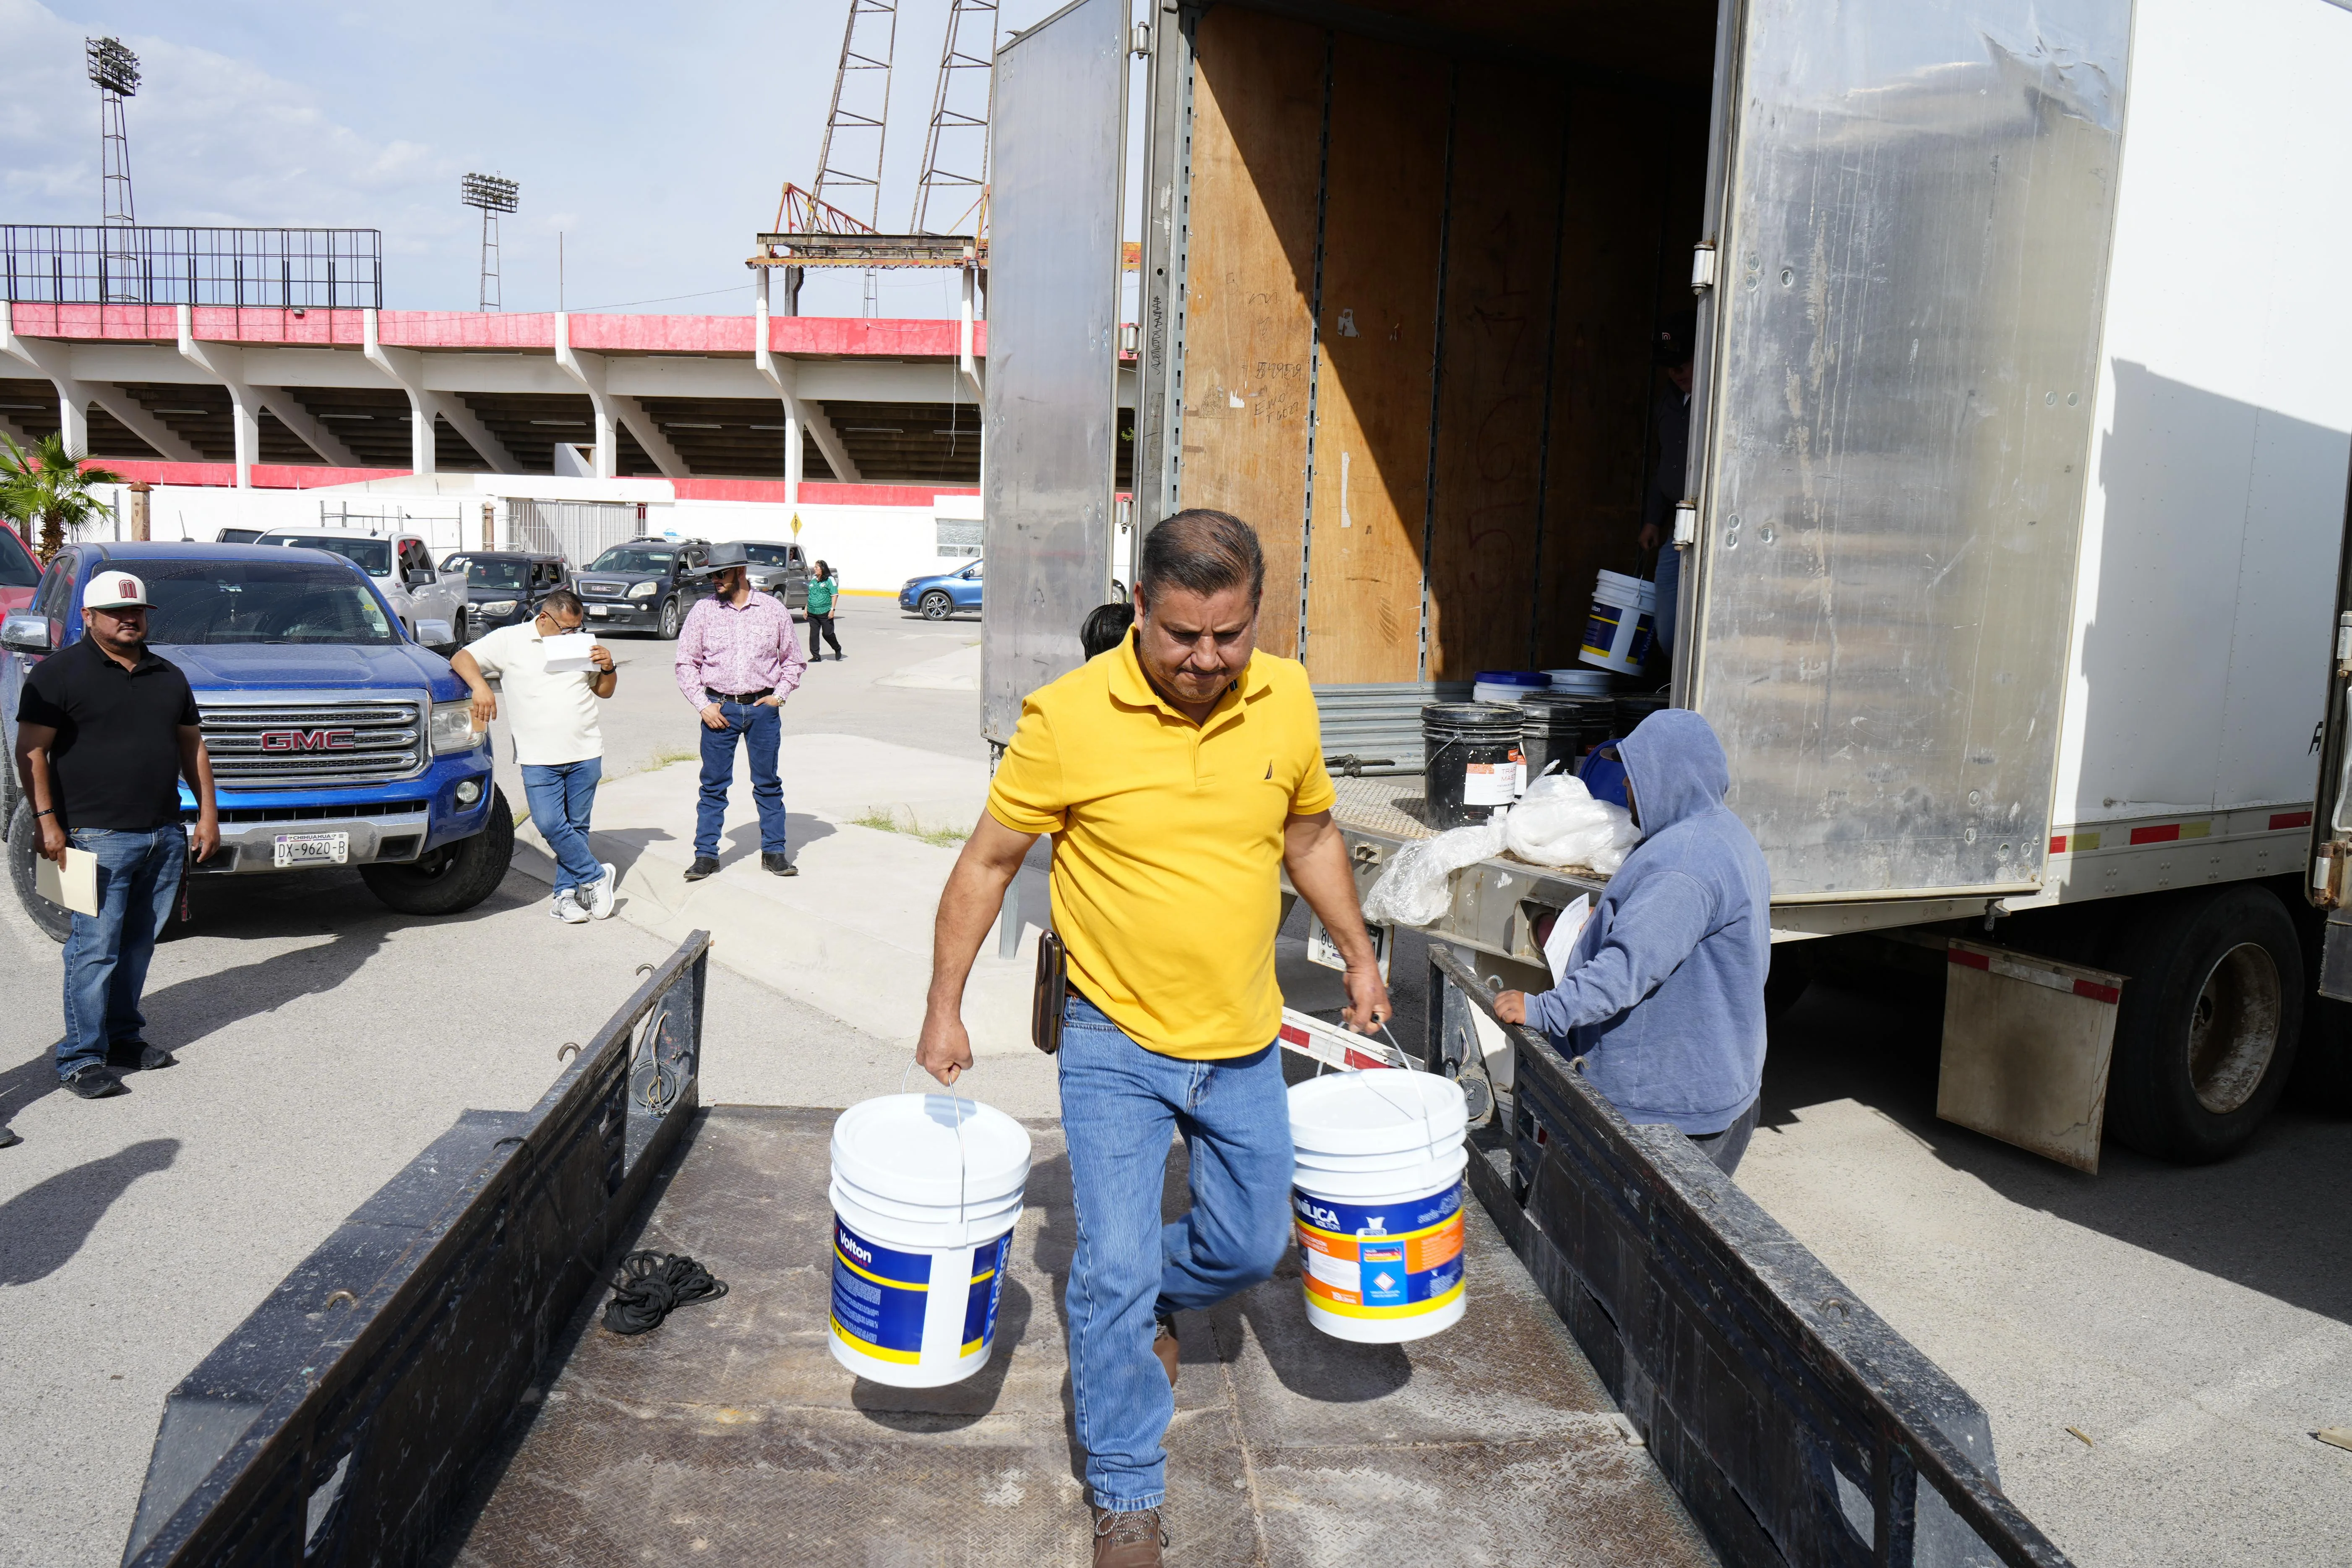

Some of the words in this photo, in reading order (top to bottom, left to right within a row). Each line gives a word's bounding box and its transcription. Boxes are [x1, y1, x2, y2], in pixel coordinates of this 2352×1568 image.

[1642, 624, 1656, 652] Volto
[261, 728, 355, 751] GMC
[278, 841, 345, 858] DX-9620-B
[840, 1229, 871, 1263] Volton
